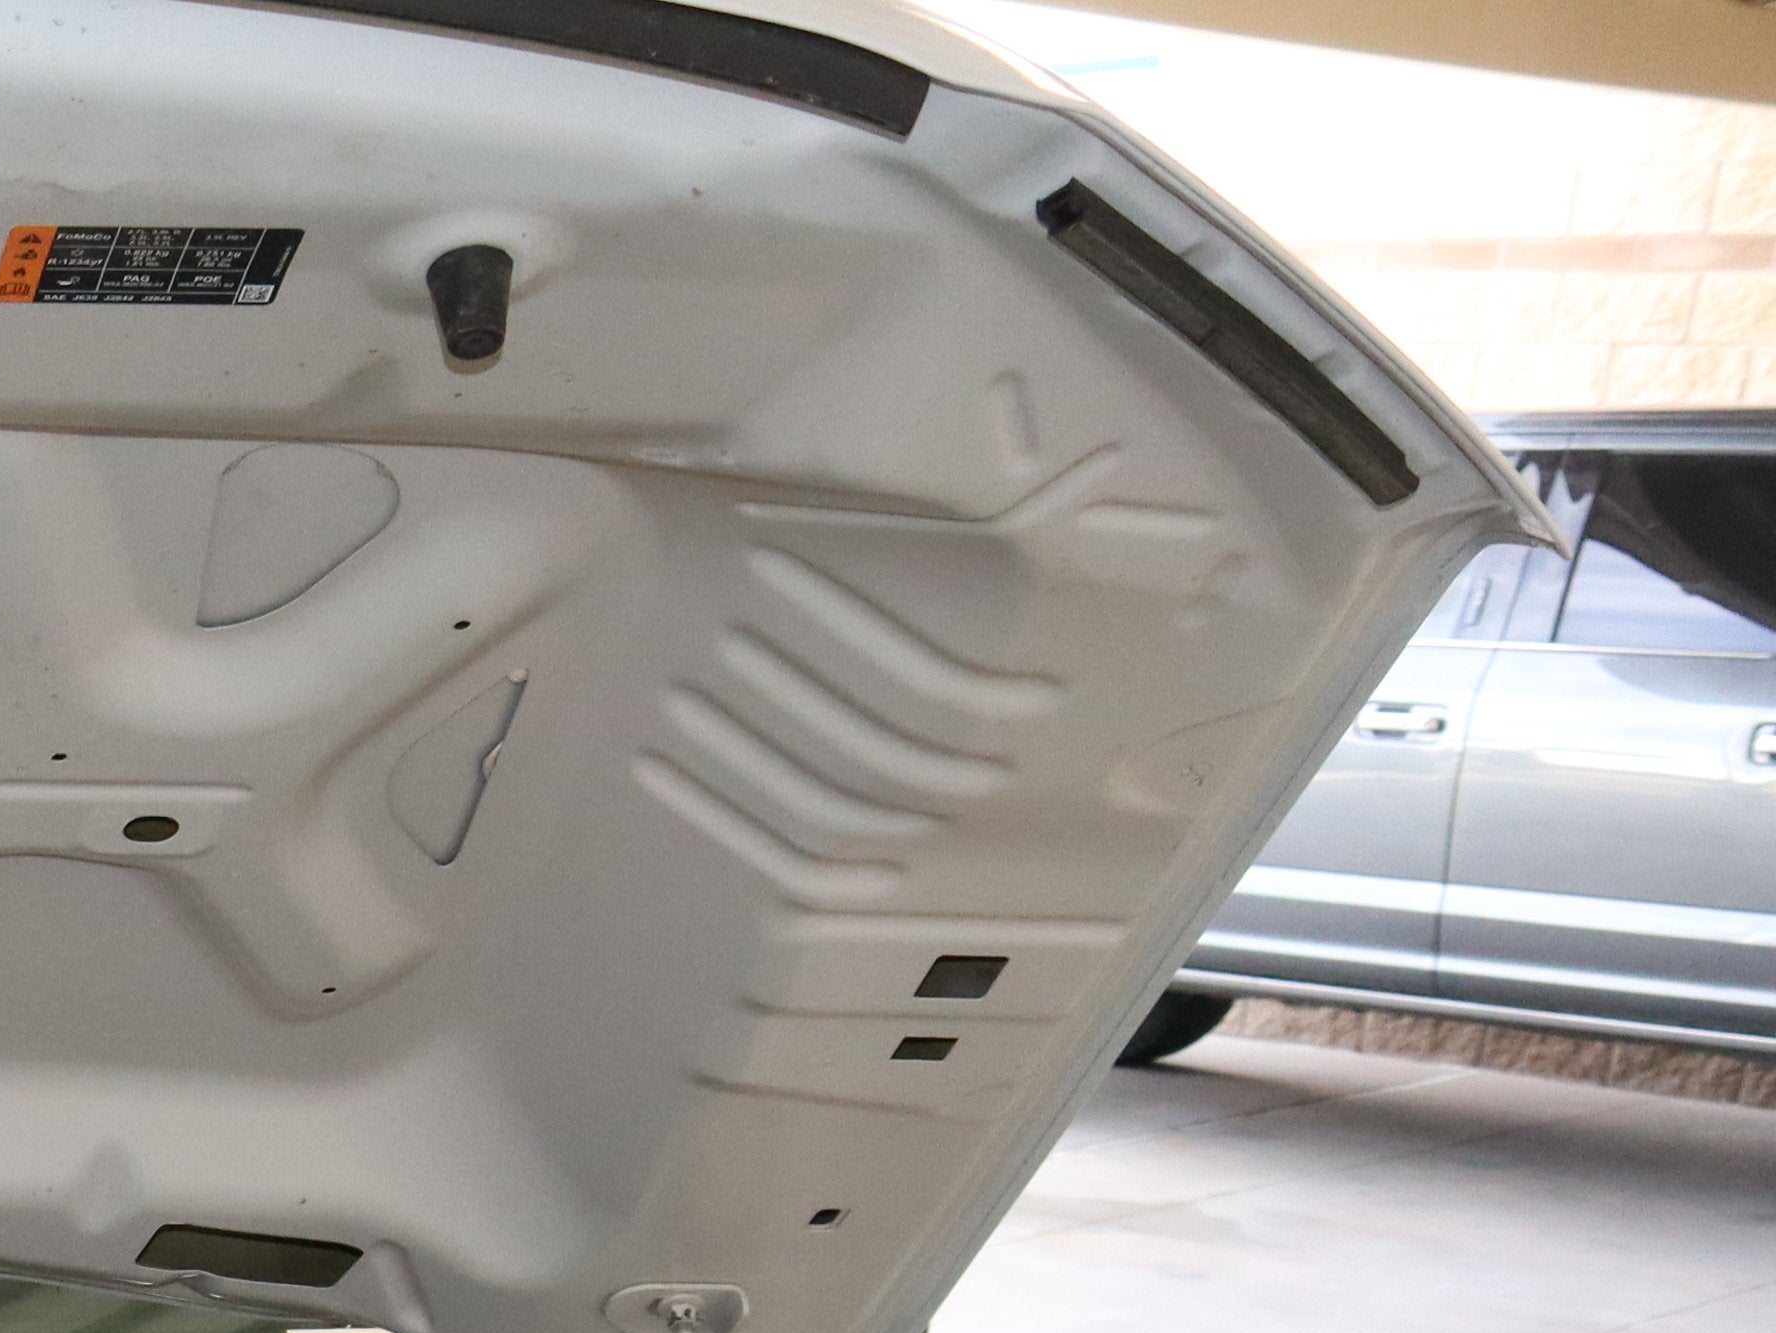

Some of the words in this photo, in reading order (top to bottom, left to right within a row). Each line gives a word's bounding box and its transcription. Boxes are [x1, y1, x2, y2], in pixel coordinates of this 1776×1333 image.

[56, 233, 112, 241] FoMoCo
[155, 250, 170, 258] kg
[227, 251, 242, 259] kg
[47, 257, 103, 267] R-1234yf
[123, 274, 151, 282] PAG
[193, 275, 222, 283] POE
